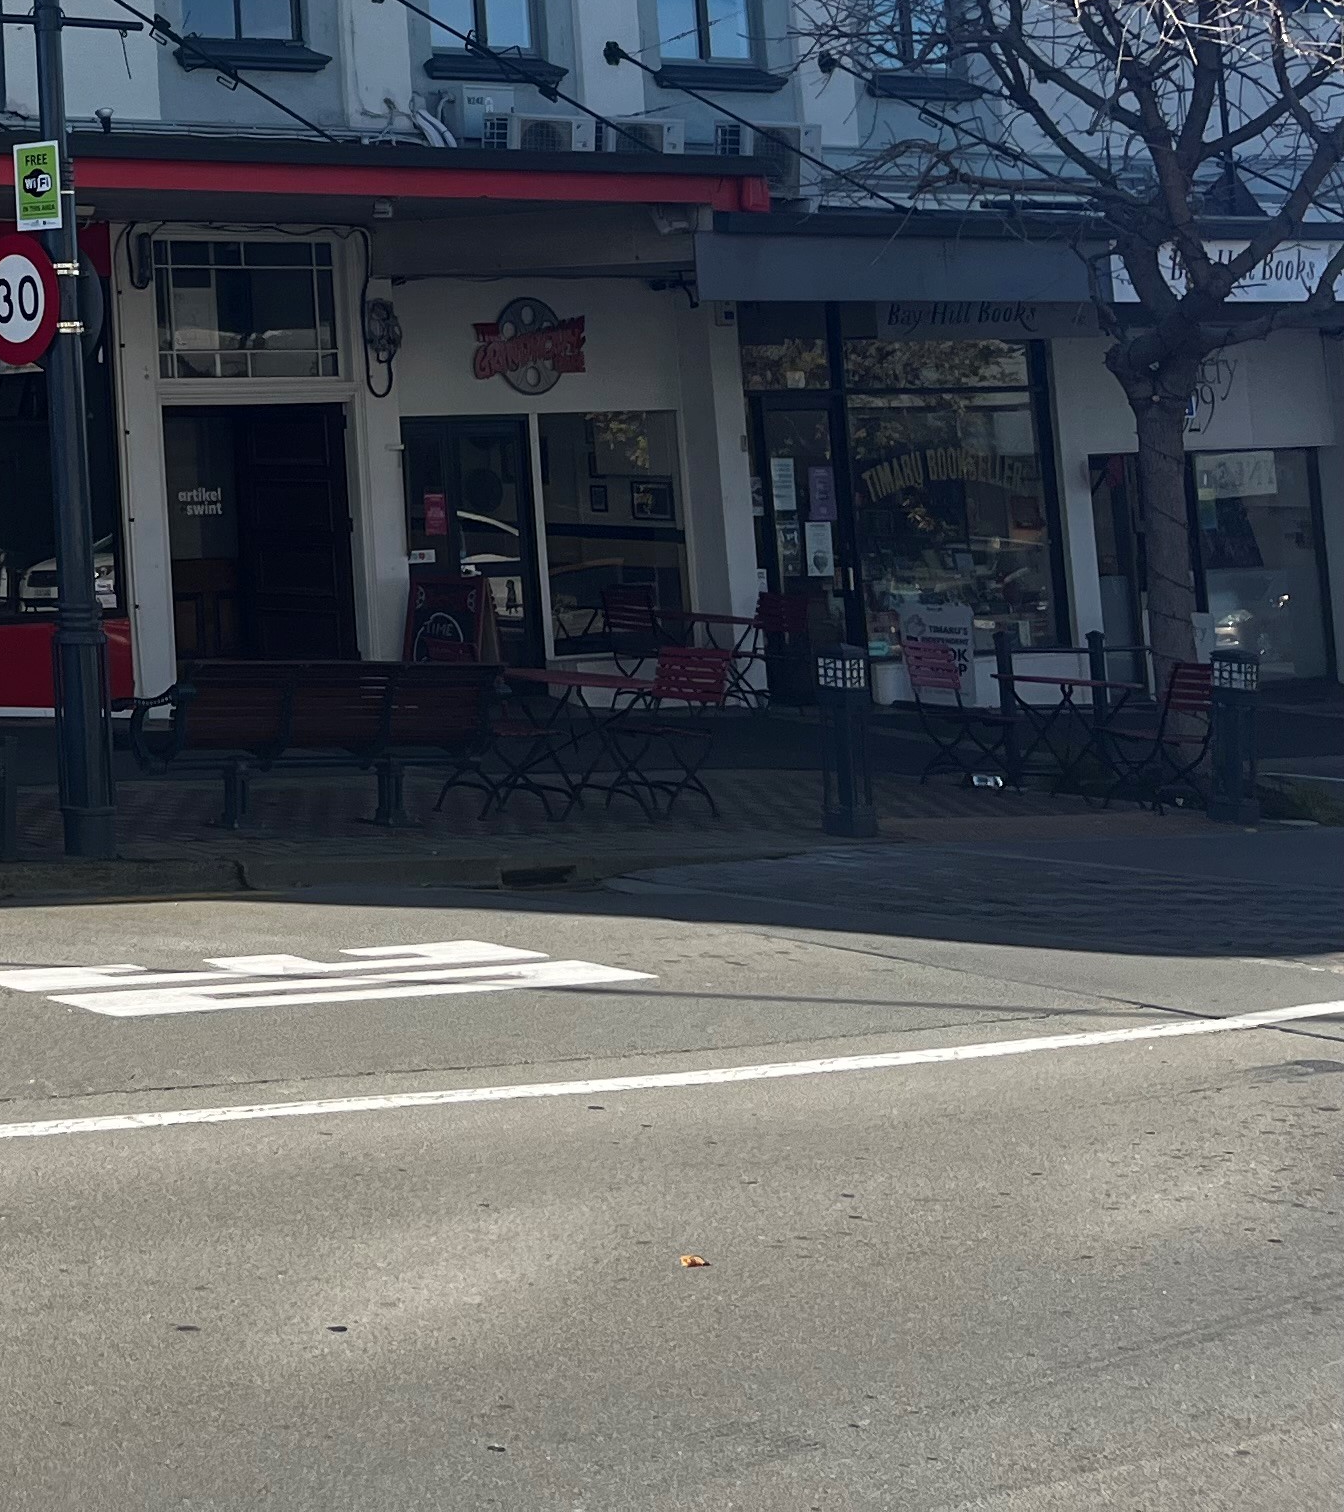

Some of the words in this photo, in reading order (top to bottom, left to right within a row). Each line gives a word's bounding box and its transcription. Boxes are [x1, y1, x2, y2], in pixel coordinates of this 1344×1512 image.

[25, 154, 48, 166] FREE
[1263, 248, 1316, 288] Books
[887, 302, 922, 335] Bay
[930, 301, 973, 326] Hill
[977, 300, 1038, 333] Books
[862, 450, 924, 503] TIMARU
[177, 486, 222, 502] artikel
[186, 500, 223, 516] swint
